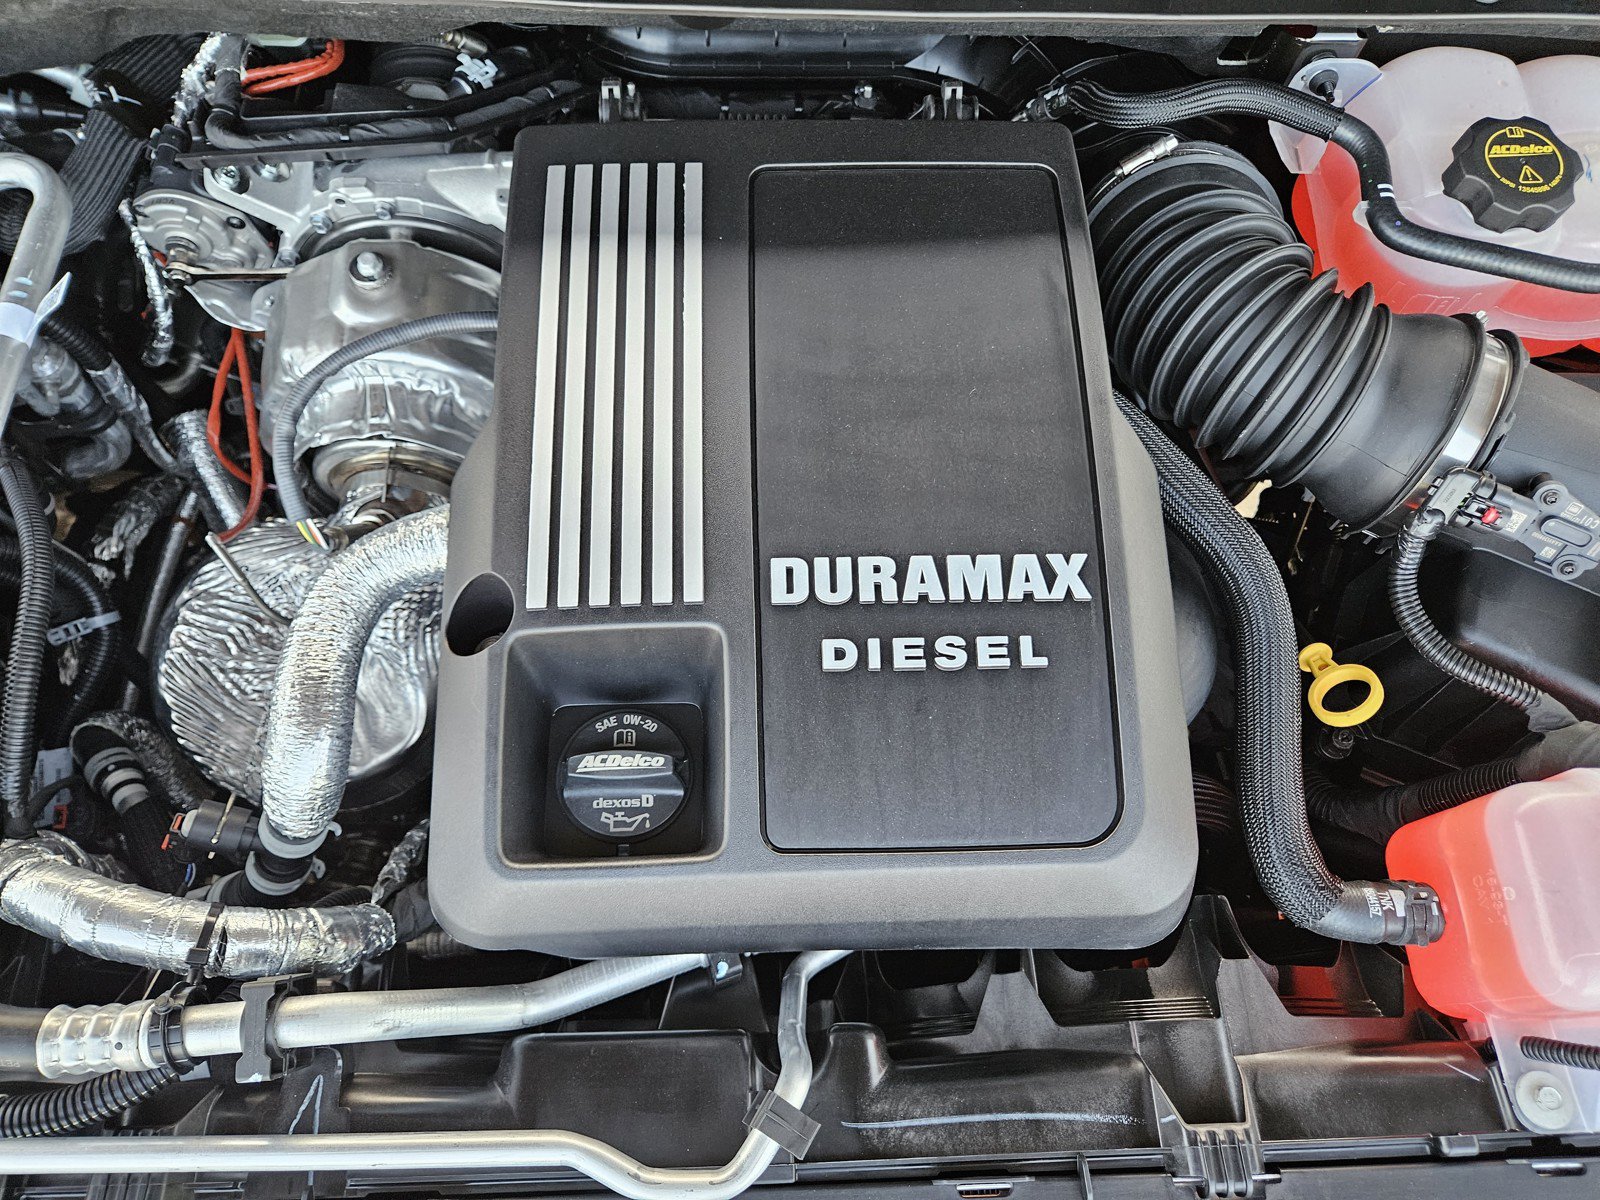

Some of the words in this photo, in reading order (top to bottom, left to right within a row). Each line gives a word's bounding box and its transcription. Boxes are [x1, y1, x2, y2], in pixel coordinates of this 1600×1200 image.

[1489, 144, 1554, 154] ACDelco
[770, 553, 1092, 606] DURAMAX
[821, 635, 1049, 672] DIESEL
[595, 715, 618, 733] SAE
[623, 714, 658, 733] 0W-20
[577, 753, 666, 769] ACDelco
[592, 794, 654, 809] dexosD
[1377, 891, 1395, 911] TNK
